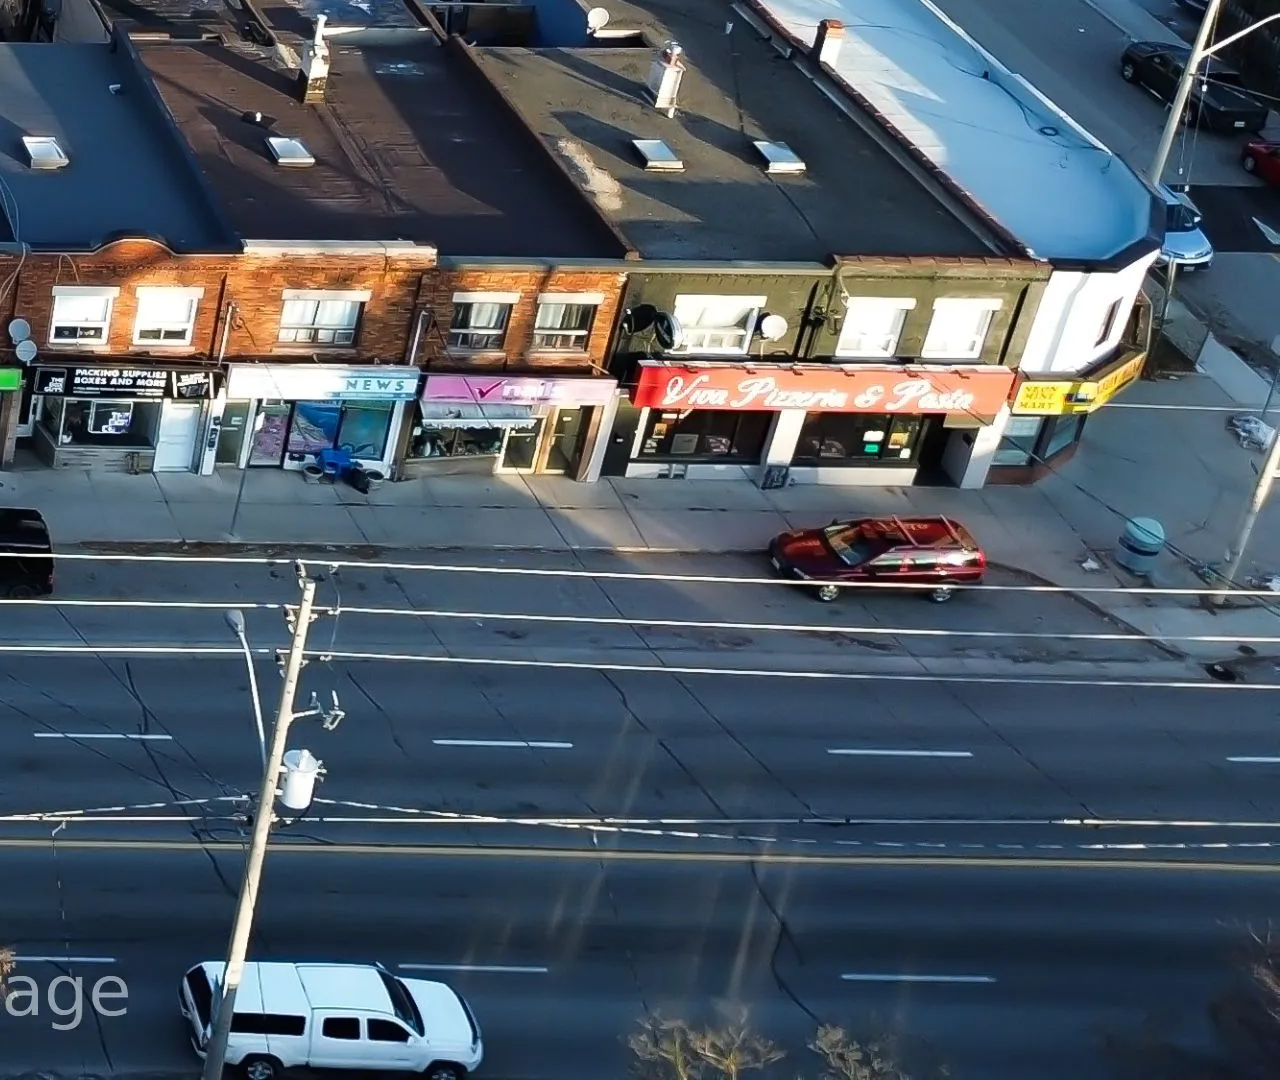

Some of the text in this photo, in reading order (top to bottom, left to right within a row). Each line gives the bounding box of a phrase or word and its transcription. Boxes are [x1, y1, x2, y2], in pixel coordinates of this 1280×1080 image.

[75, 369, 167, 378] PACKING SUPPLIES
[74, 377, 107, 385] BOXES
[136, 379, 166, 387] MORE
[345, 378, 407, 392] NEWS
[662, 375, 974, 410] Viva Pizzeria & Pasta
